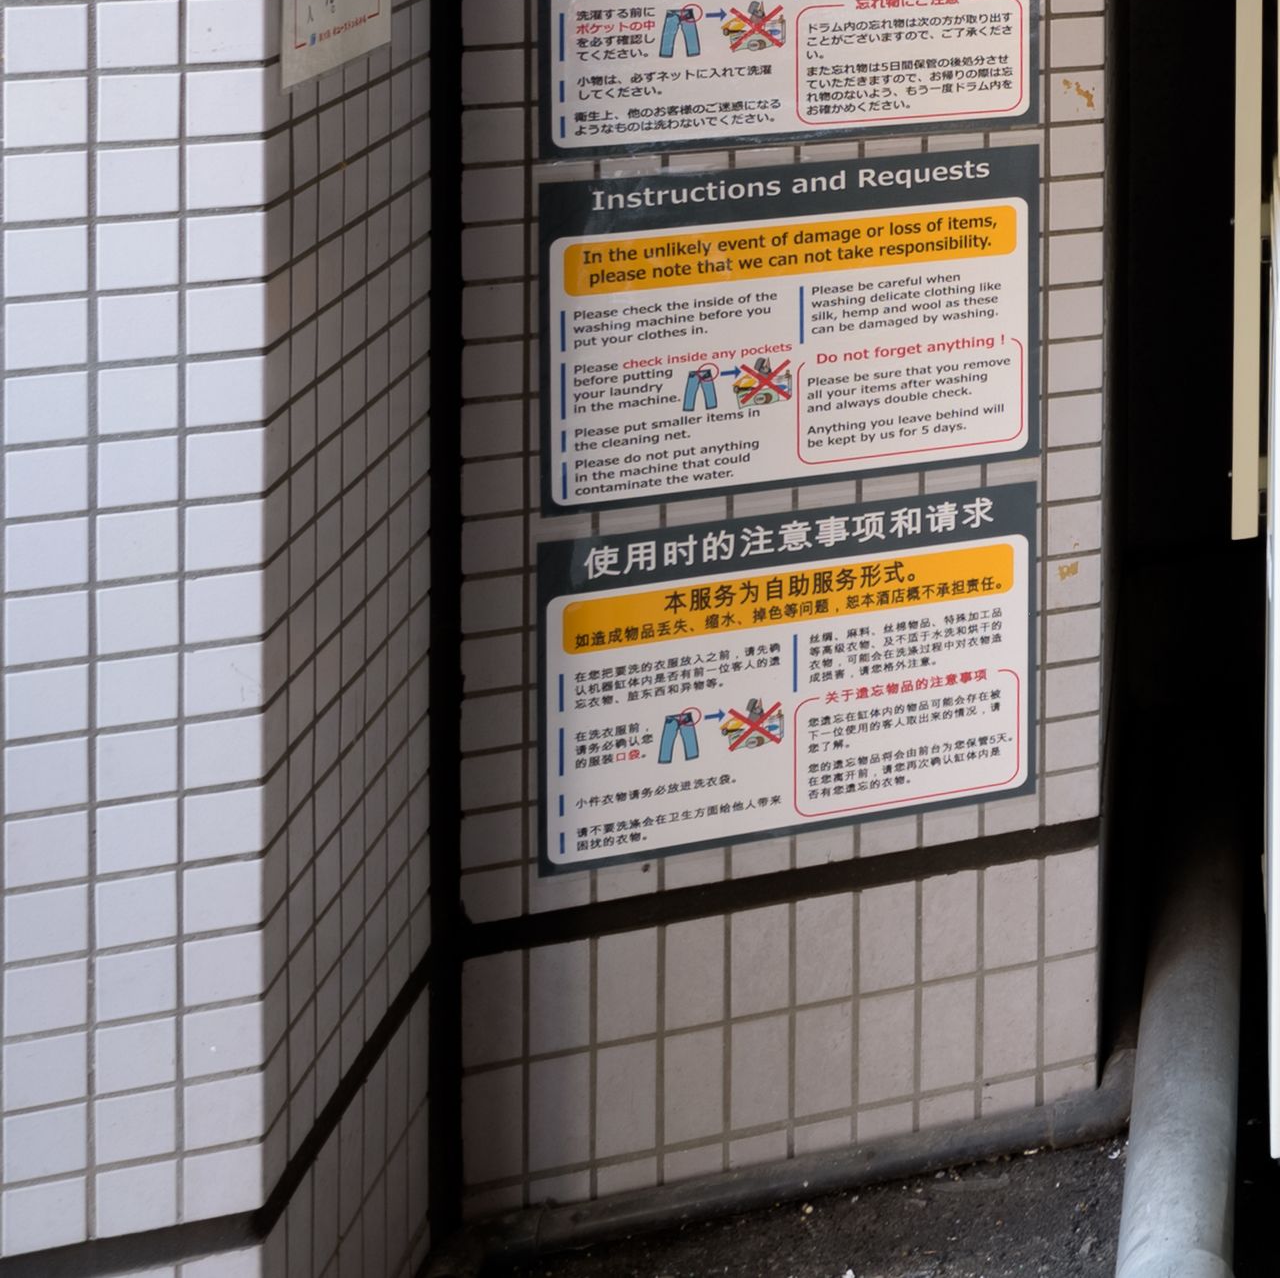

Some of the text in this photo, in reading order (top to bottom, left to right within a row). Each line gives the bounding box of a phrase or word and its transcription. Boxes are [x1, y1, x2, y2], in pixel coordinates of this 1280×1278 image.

[576, 6, 656, 21] 洗濯する前に
[576, 20, 656, 35] ポケットの中
[576, 35, 656, 49] を必ず確認し
[577, 49, 651, 62] てください。
[577, 64, 773, 87] 小物は、必ずネットに入れて洗濯
[578, 85, 663, 101] してください。
[592, 160, 990, 211] Instructions and Requests
[583, 215, 997, 265] In the unlikely event of damage or loss of items,
[589, 234, 992, 288] please note that we can not take responsibility.
[573, 307, 771, 334] washing machine before you
[574, 291, 778, 321] Please check the inside of the
[574, 326, 708, 349] put your clothes in.
[816, 352, 838, 365] Do
[843, 349, 869, 362] not
[874, 343, 922, 359] forget
[927, 336, 995, 353] anything
[584, 497, 995, 579] 使用时的注意事项和请求
[664, 561, 916, 614] 本服务为自助服务形式。
[574, 678, 724, 709] 忘衣物、脏东西和异物等。
[825, 669, 988, 704] 关于遗忘物品的注意事项
[574, 734, 653, 756] 请务必确认您
[575, 773, 737, 809] 小件衣物请务必放进洗衣袋。
